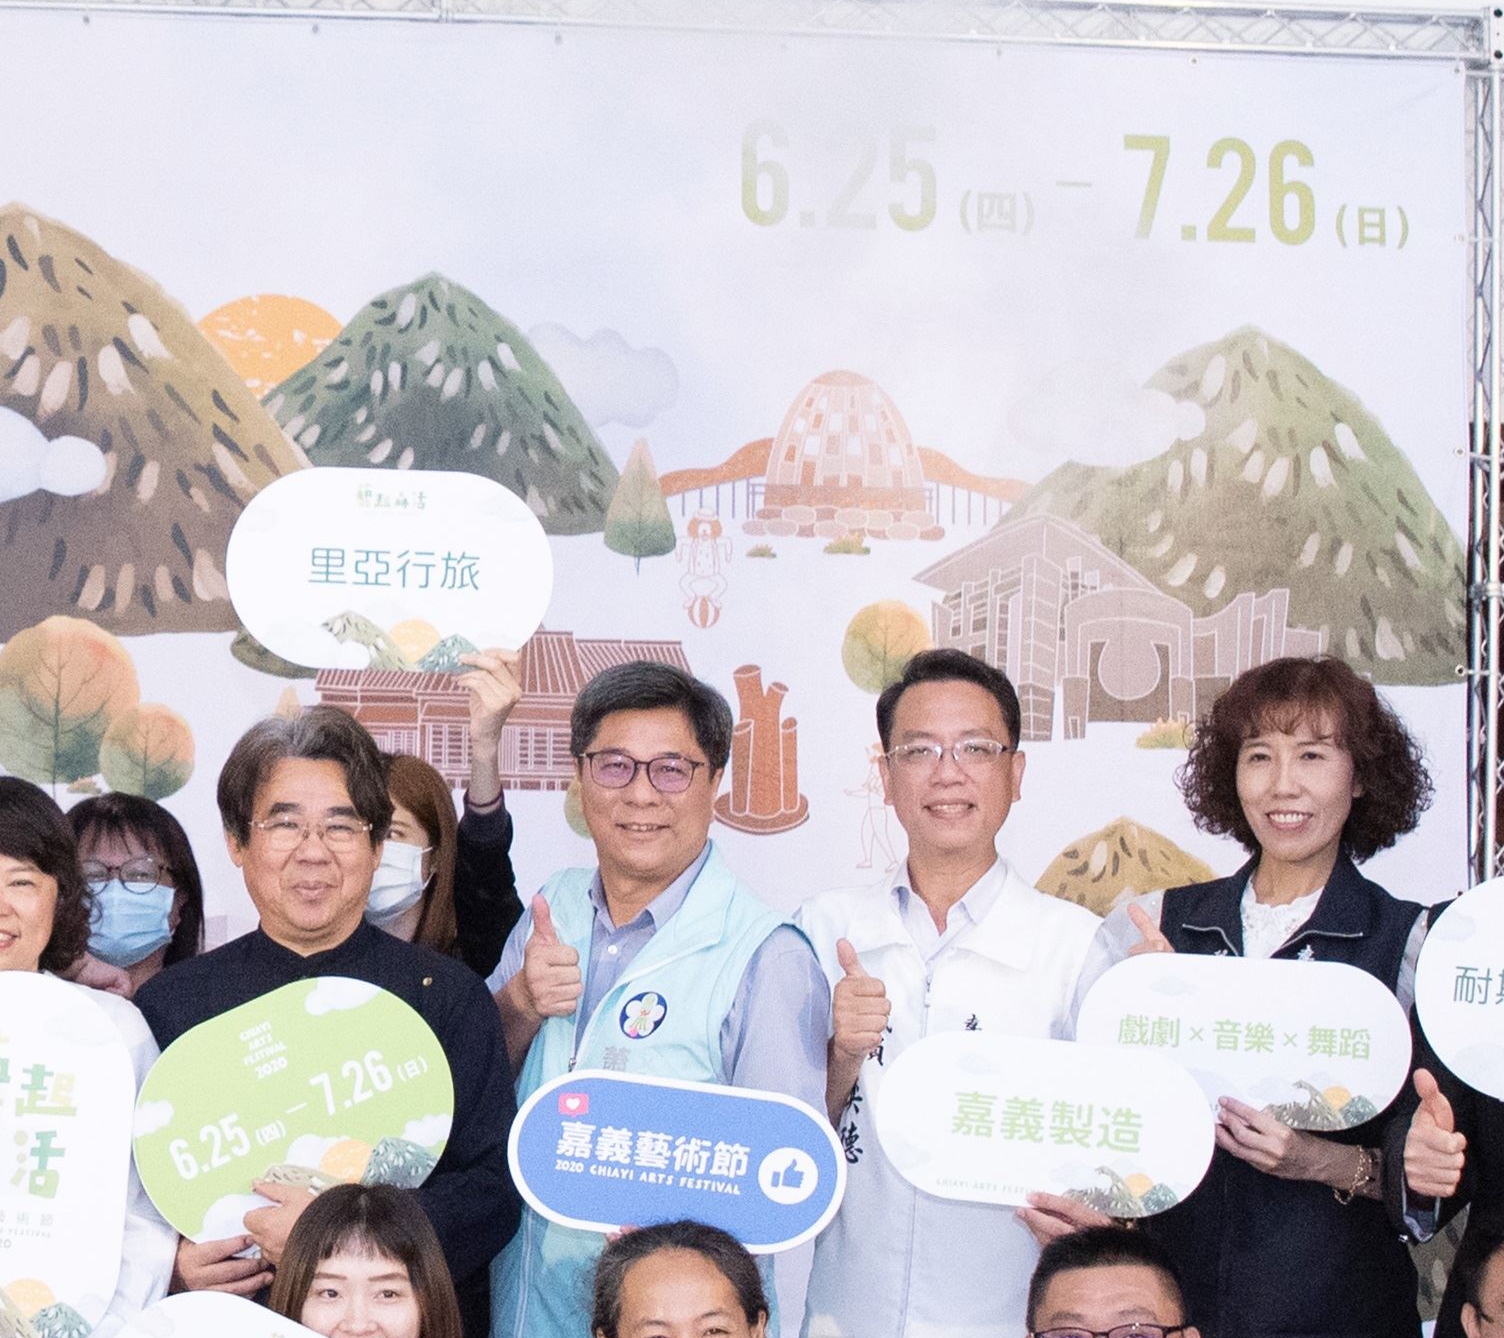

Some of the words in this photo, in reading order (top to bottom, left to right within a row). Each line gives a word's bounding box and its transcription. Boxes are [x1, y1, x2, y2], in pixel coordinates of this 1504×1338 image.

[740, 117, 938, 232] 6.25
[1123, 134, 1315, 247] 7.26
[308, 547, 480, 591] 里亞行旅
[255, 1058, 289, 1080] 2020
[168, 1114, 252, 1181] 6.25
[309, 1049, 393, 1116] 7.26
[951, 1091, 1143, 1154] 嘉義製造
[555, 1160, 583, 1174] 2020
[589, 1165, 633, 1180] CHIAYI
[640, 1171, 673, 1185] ARTS
[679, 1176, 741, 1195] FESTIVAL
[556, 1119, 750, 1179] 嘉義藝術節
